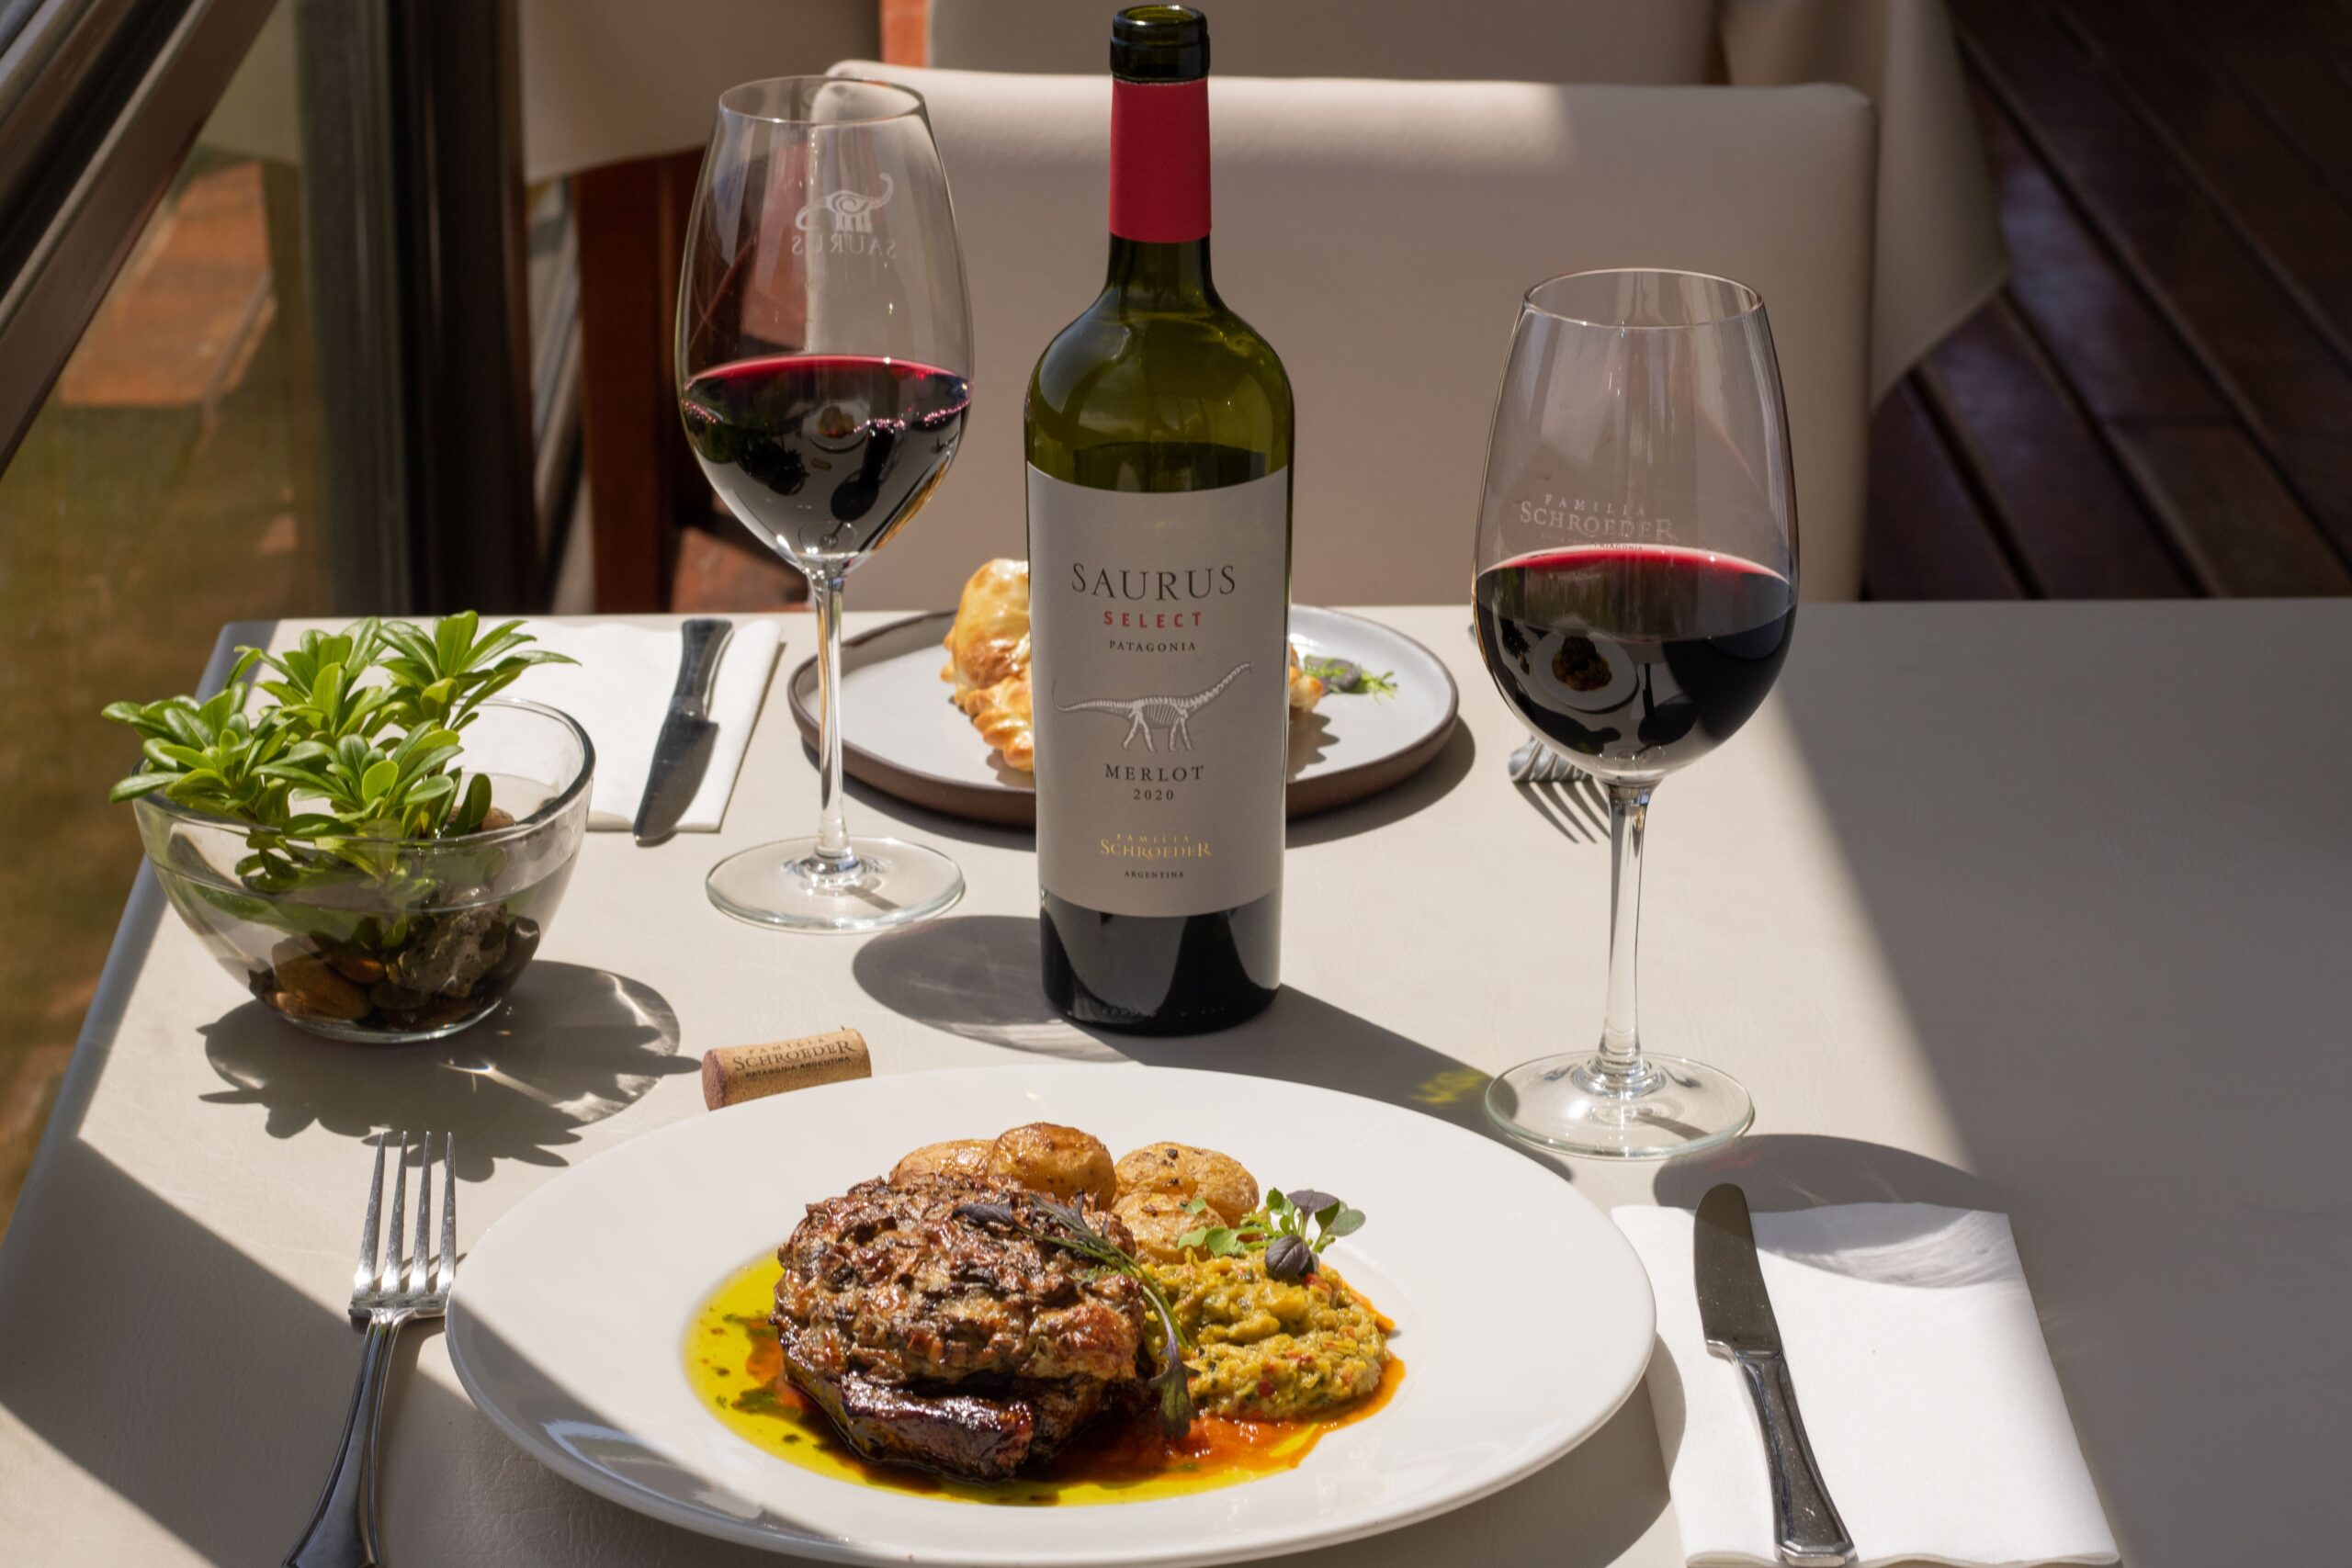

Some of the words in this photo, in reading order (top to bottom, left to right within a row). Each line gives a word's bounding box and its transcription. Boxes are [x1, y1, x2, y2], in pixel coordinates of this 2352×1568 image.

[1544, 493, 1645, 516] FAMILIA
[1520, 501, 1679, 542] SCHROEDER
[1071, 562, 1236, 601] SAURUS
[1103, 610, 1202, 628] SELECT
[1109, 639, 1196, 652] PATAGONIA
[1104, 763, 1204, 782] MERLOT
[1133, 788, 1174, 801] 2020
[1116, 833, 1190, 843] FAMILIA
[1100, 838, 1213, 861] SCHROEDER
[1124, 870, 1185, 879] ARGENTINA
[732, 1039, 857, 1072] SCHROEDER
[748, 1037, 825, 1055] FAMILIA
[745, 1065, 797, 1078] PATAGONIA
[798, 1055, 852, 1070] ARGENTINA
